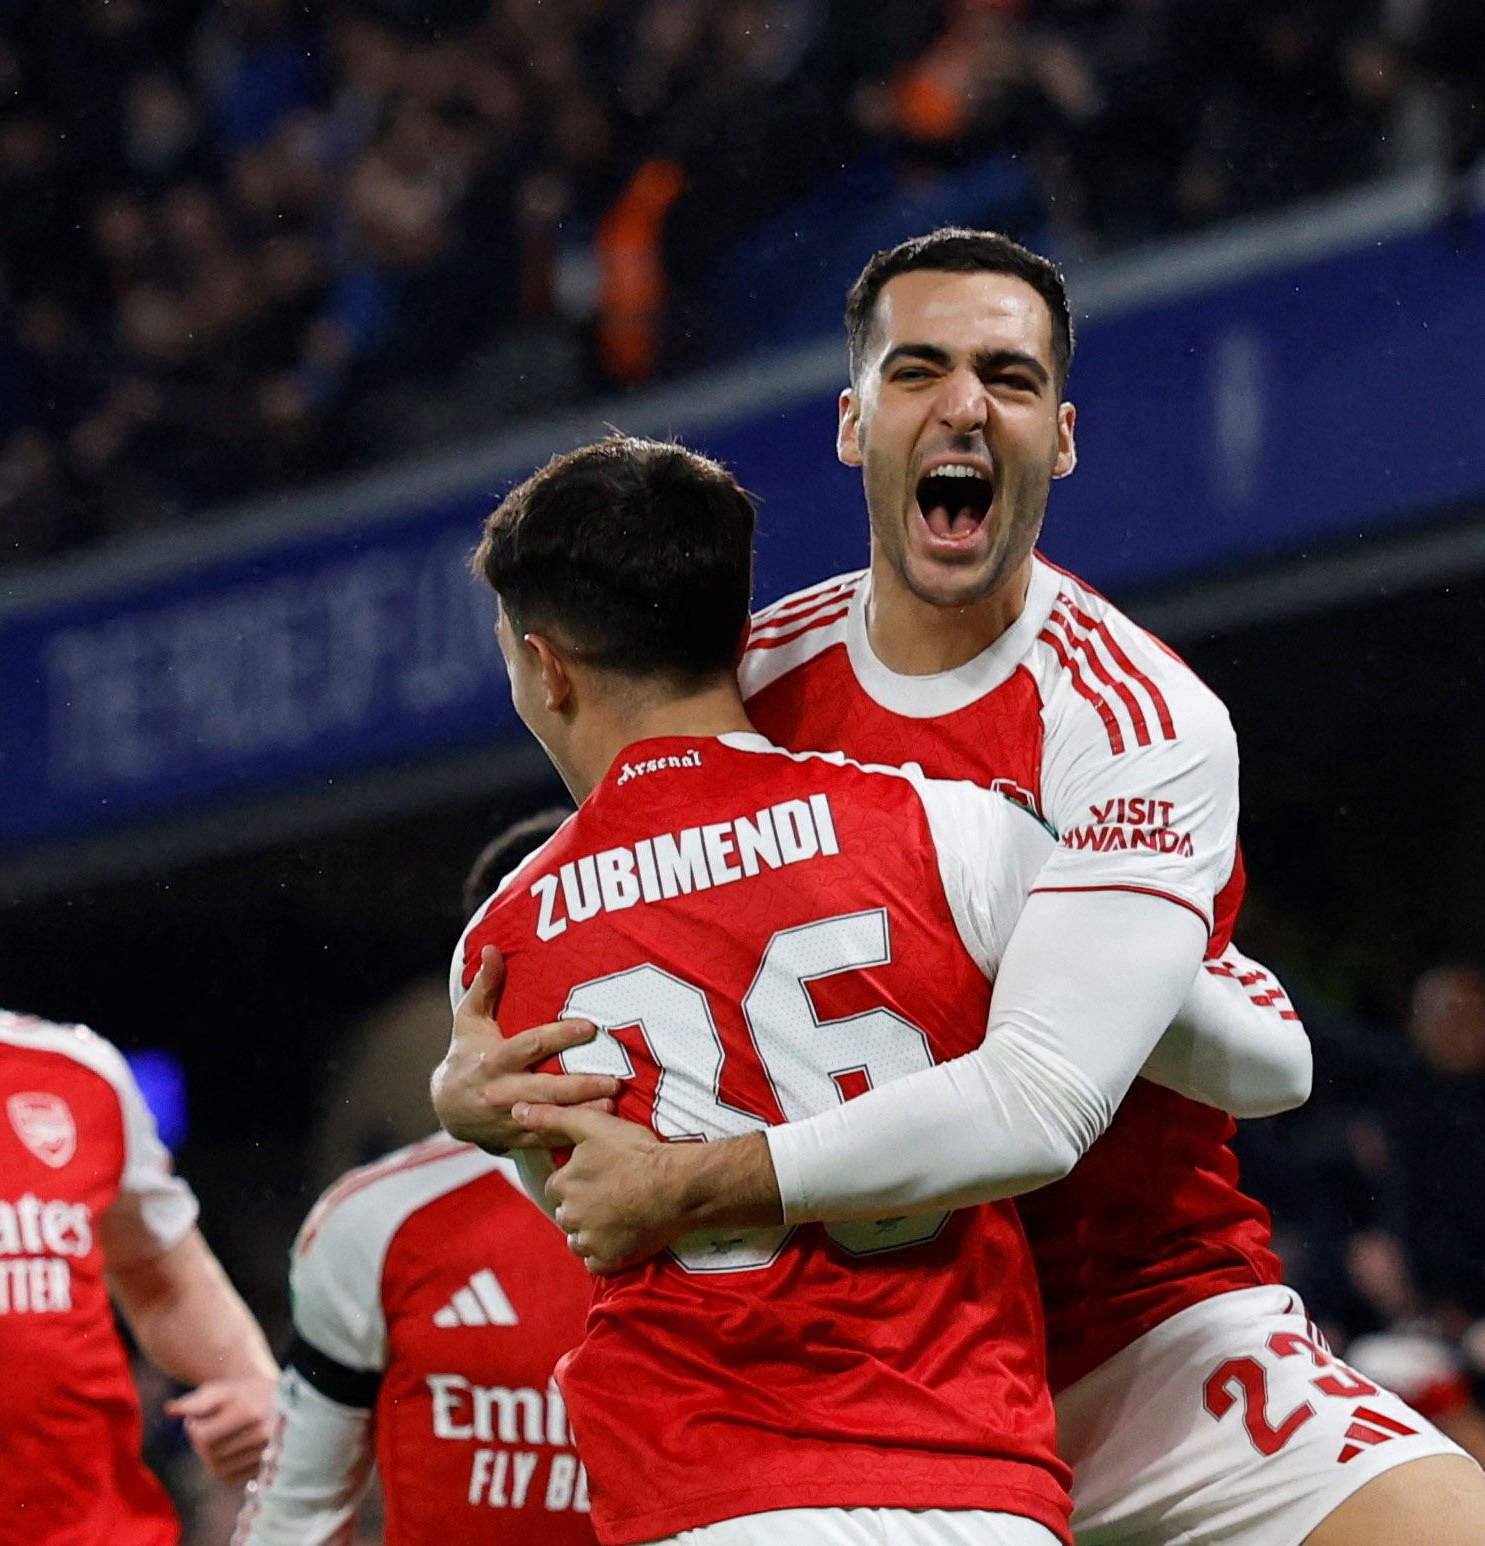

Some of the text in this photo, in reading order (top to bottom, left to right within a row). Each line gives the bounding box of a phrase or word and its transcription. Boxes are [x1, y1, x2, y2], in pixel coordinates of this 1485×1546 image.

[617, 748, 702, 786] Arsenal
[1089, 797, 1175, 827] VISIT
[530, 793, 839, 942] ZUBIMENDI
[1202, 1331, 1380, 1457] 23
[468, 1448, 539, 1510] FLY
